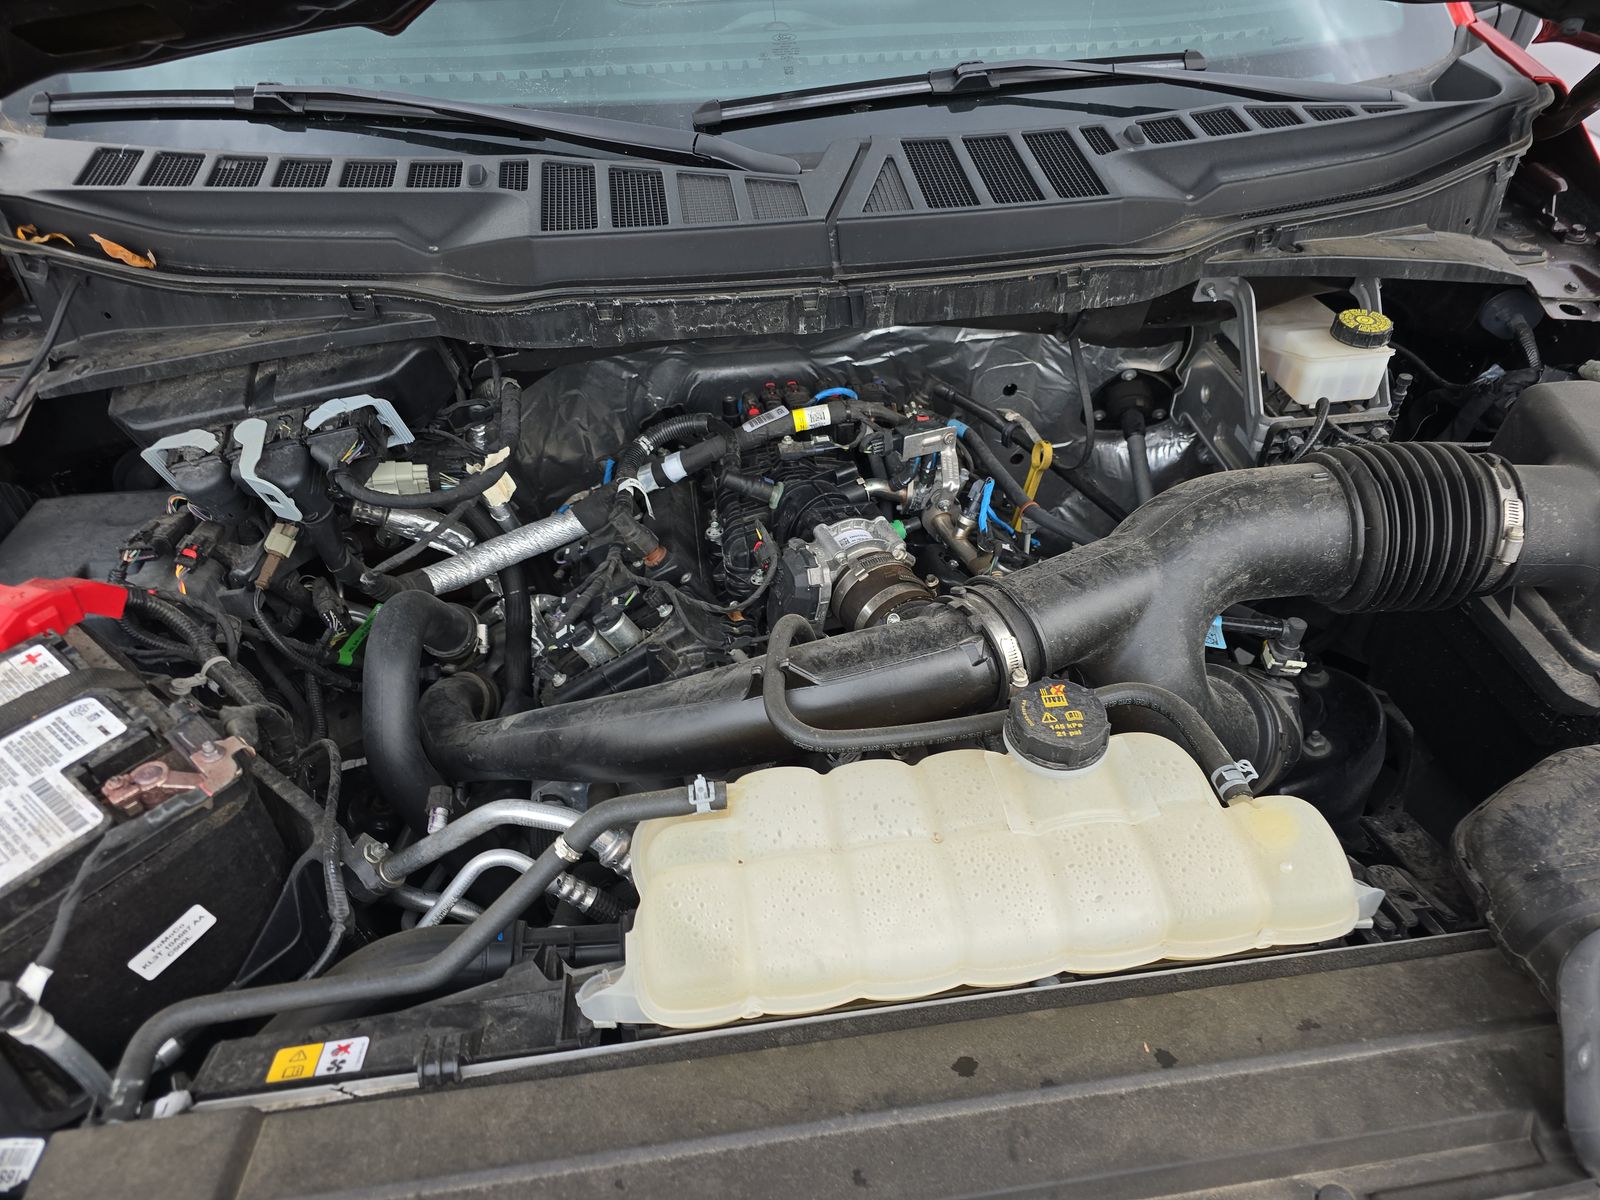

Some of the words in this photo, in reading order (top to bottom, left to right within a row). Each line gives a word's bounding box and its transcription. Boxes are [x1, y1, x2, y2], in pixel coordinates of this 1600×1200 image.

[1069, 729, 1082, 737] psi
[193, 915, 205, 926] AA
[151, 924, 185, 952] FoMoCo
